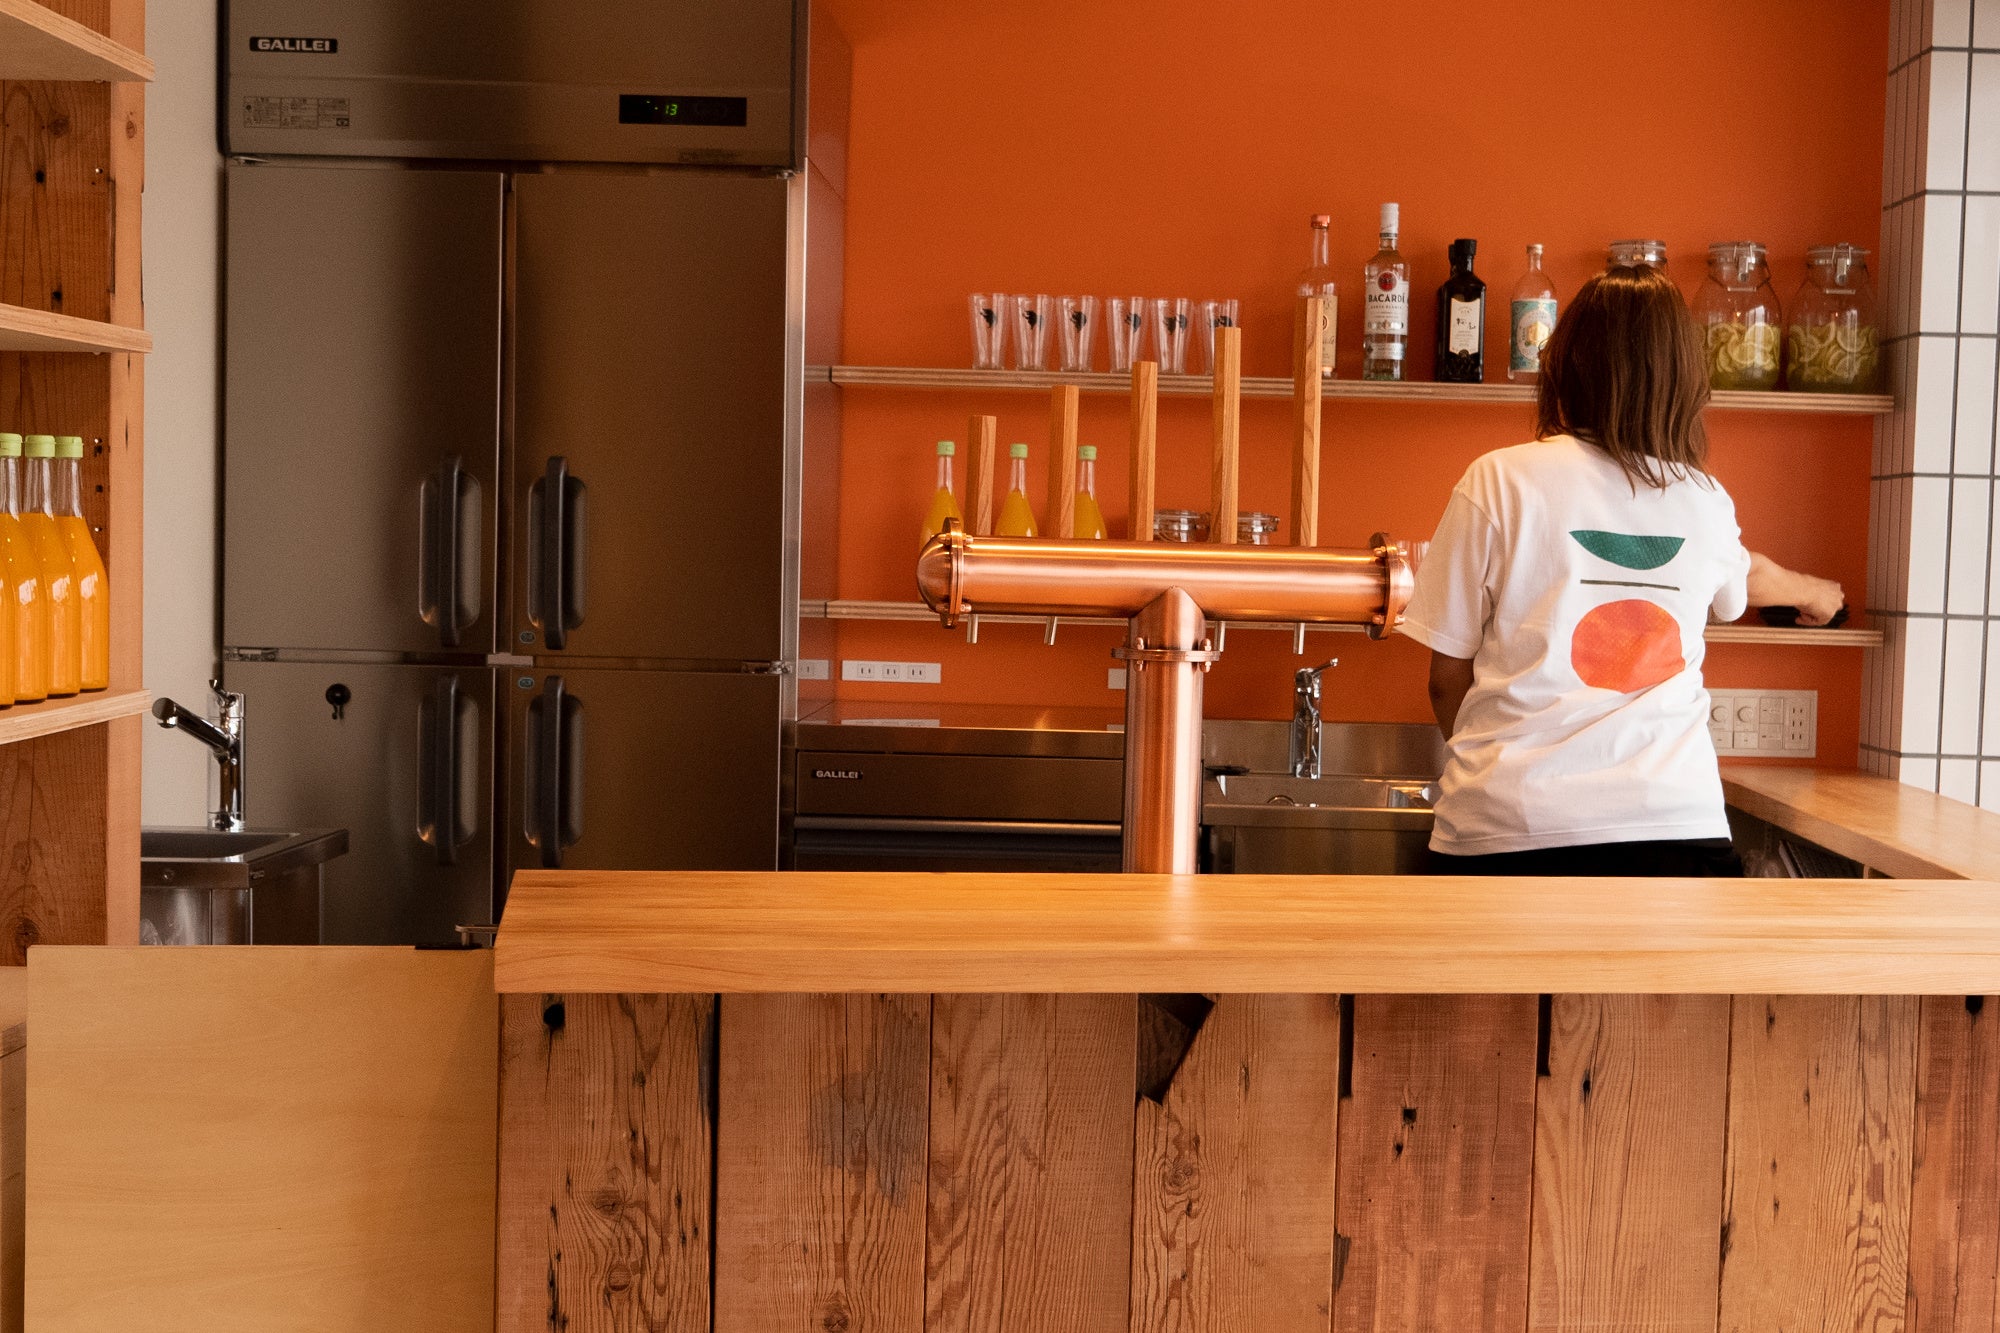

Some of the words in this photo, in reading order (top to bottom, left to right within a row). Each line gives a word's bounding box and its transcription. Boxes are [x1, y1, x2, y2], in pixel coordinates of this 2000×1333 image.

[257, 38, 331, 52] GALILEI
[665, 103, 678, 116] 13
[816, 770, 859, 779] GALILEI
